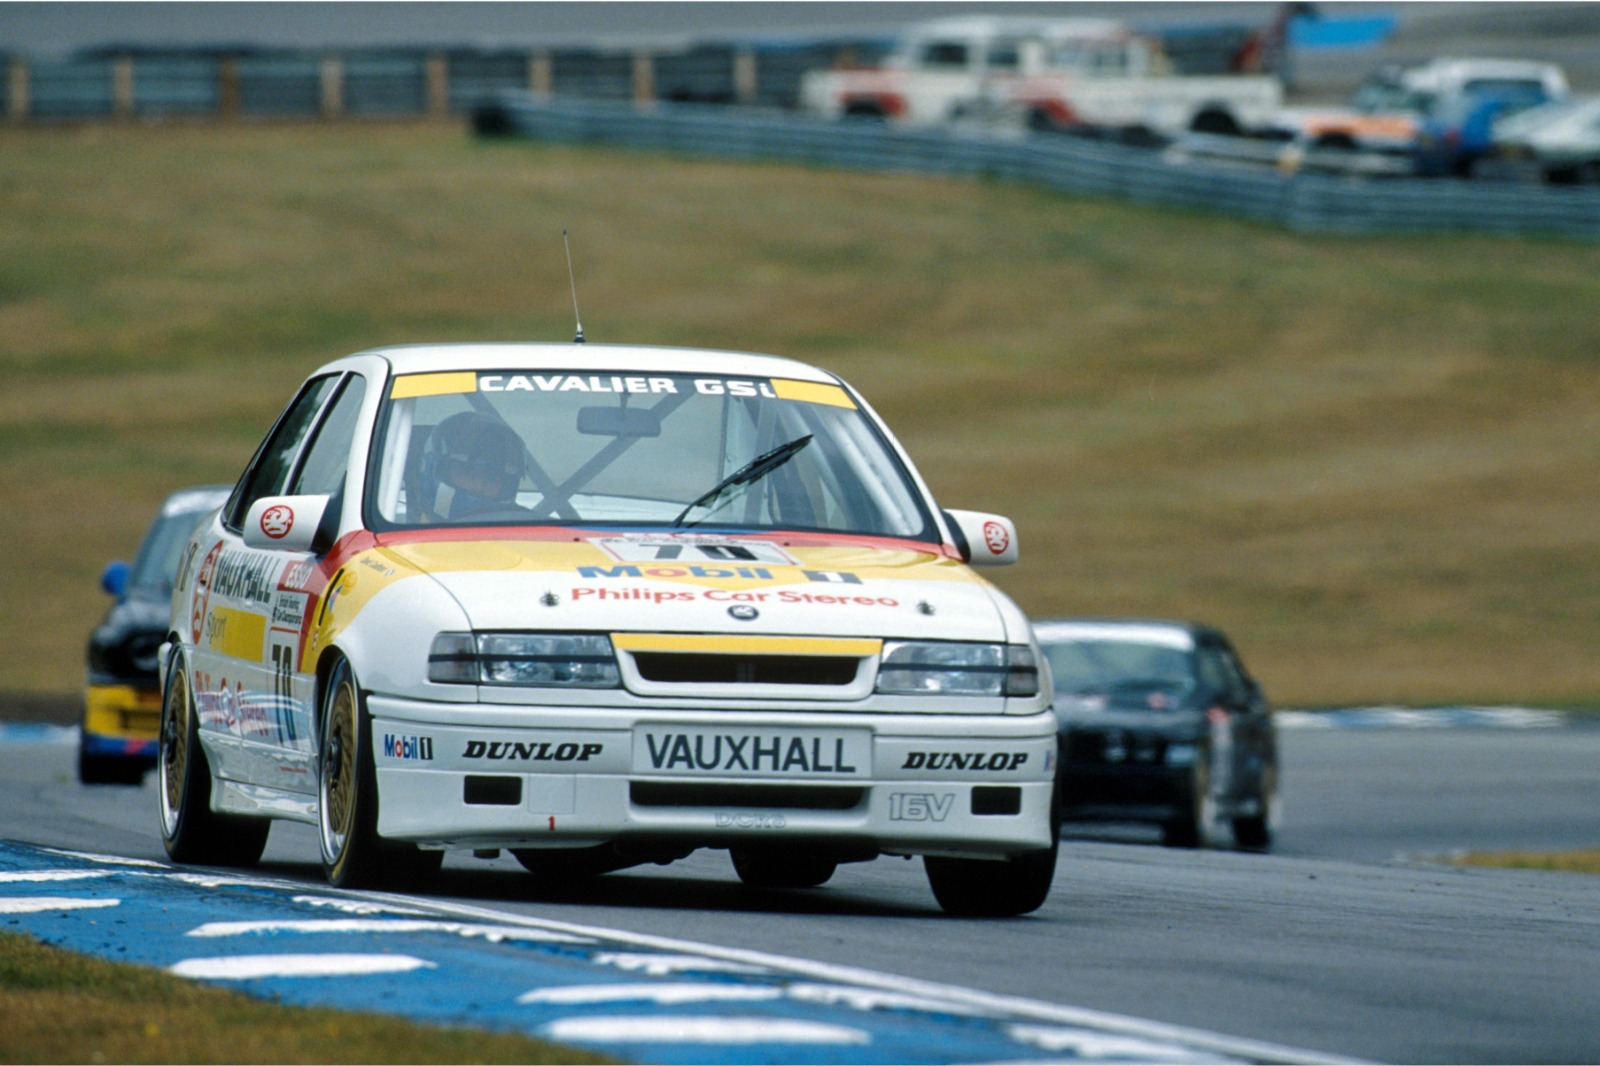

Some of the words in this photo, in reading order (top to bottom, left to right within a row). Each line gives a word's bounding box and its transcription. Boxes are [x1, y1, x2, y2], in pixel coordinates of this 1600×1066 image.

[479, 375, 678, 394] CAVALIER
[694, 378, 778, 398] GSi
[638, 543, 759, 561] 70
[213, 549, 281, 603] VAUXHALL
[576, 565, 774, 580] Mobil
[571, 587, 696, 604] Philips
[703, 589, 771, 602] Car
[777, 590, 900, 608] Stereo
[206, 611, 227, 645] Sport
[272, 644, 296, 744] 70
[384, 733, 418, 760] Mobil
[462, 740, 603, 761] DUNLOP
[646, 733, 856, 773] VAUXHALL
[901, 752, 1028, 771] DUNLOP
[889, 792, 956, 822] 16V
